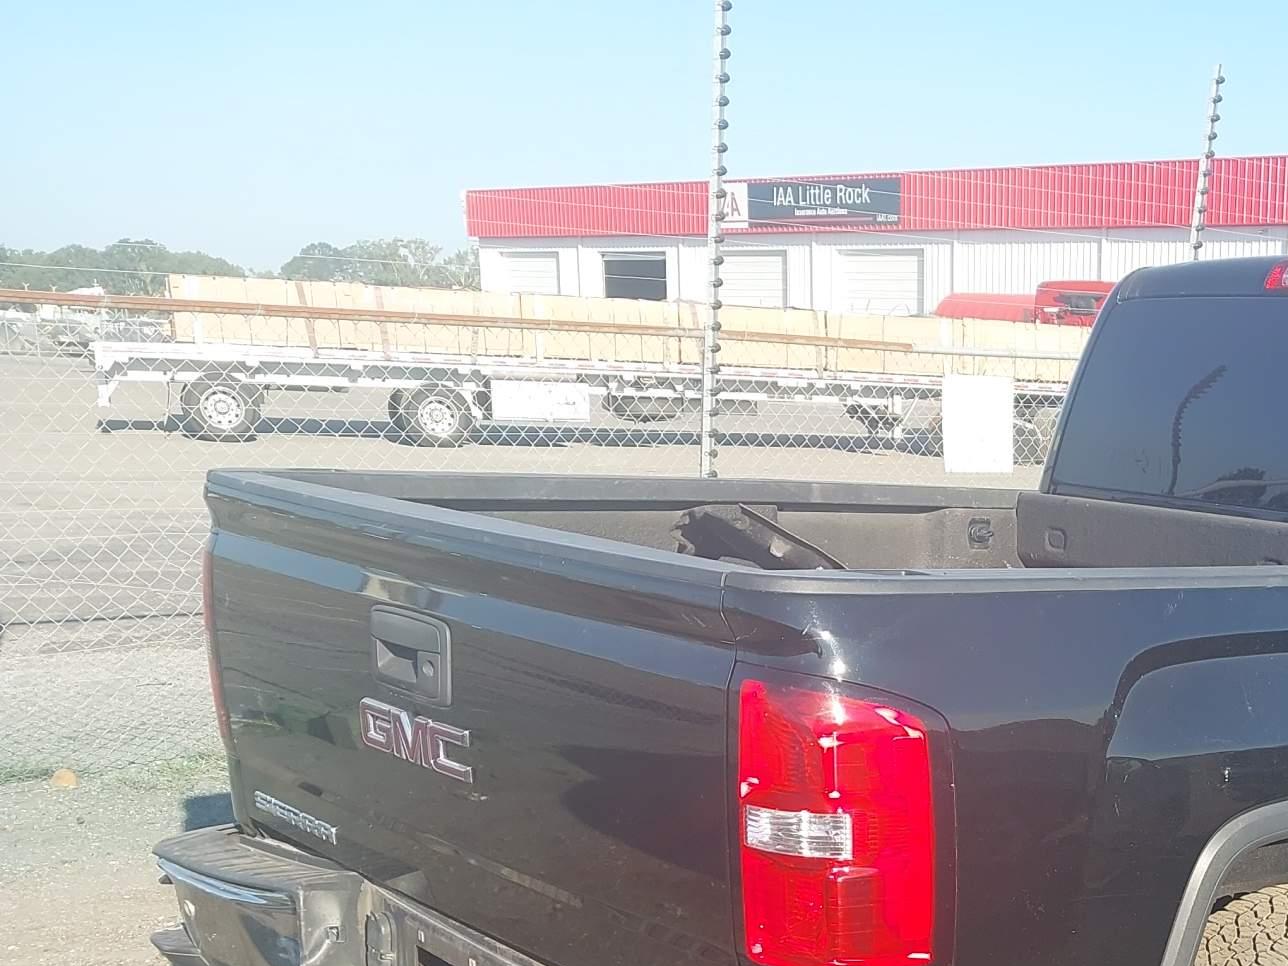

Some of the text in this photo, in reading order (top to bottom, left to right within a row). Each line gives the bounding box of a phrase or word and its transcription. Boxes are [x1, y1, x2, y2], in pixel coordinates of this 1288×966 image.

[773, 183, 871, 206] IAA Little Rock
[359, 696, 474, 785] GMC
[254, 790, 338, 845] SIERRA
